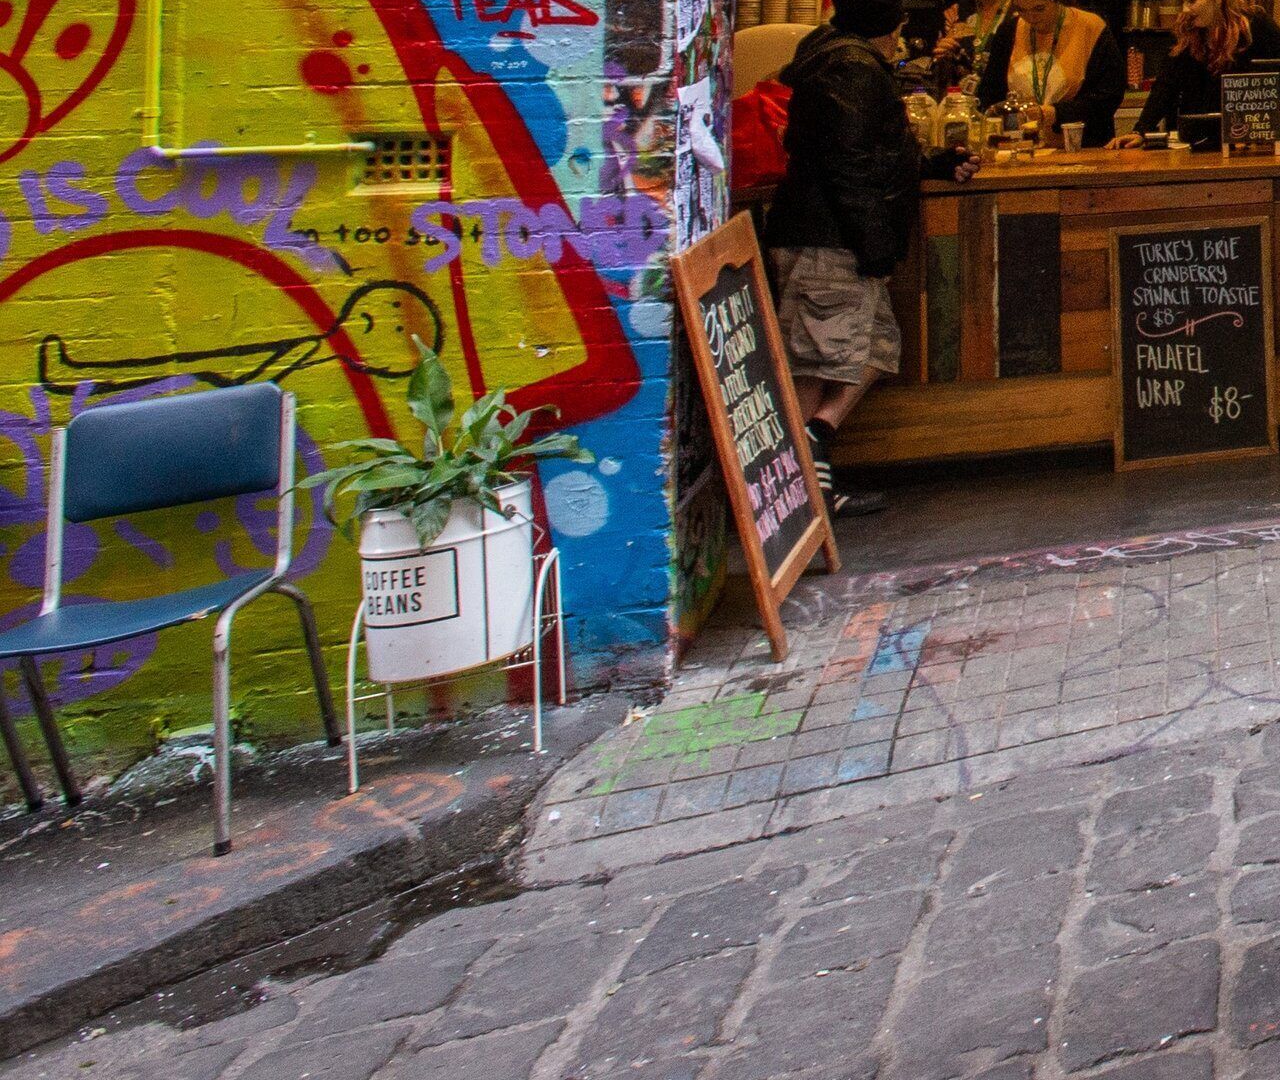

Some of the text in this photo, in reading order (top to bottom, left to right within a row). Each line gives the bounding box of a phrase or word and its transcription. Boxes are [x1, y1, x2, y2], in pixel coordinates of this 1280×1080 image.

[1133, 239, 1199, 267] TURKEY,
[1144, 264, 1228, 285] CRANBERRY
[1132, 286, 1190, 307] SPINACH
[1136, 343, 1209, 373] FALAFEL
[1136, 376, 1185, 409] WRAP
[364, 565, 426, 591] COFFEE
[367, 591, 422, 616] BEANS
